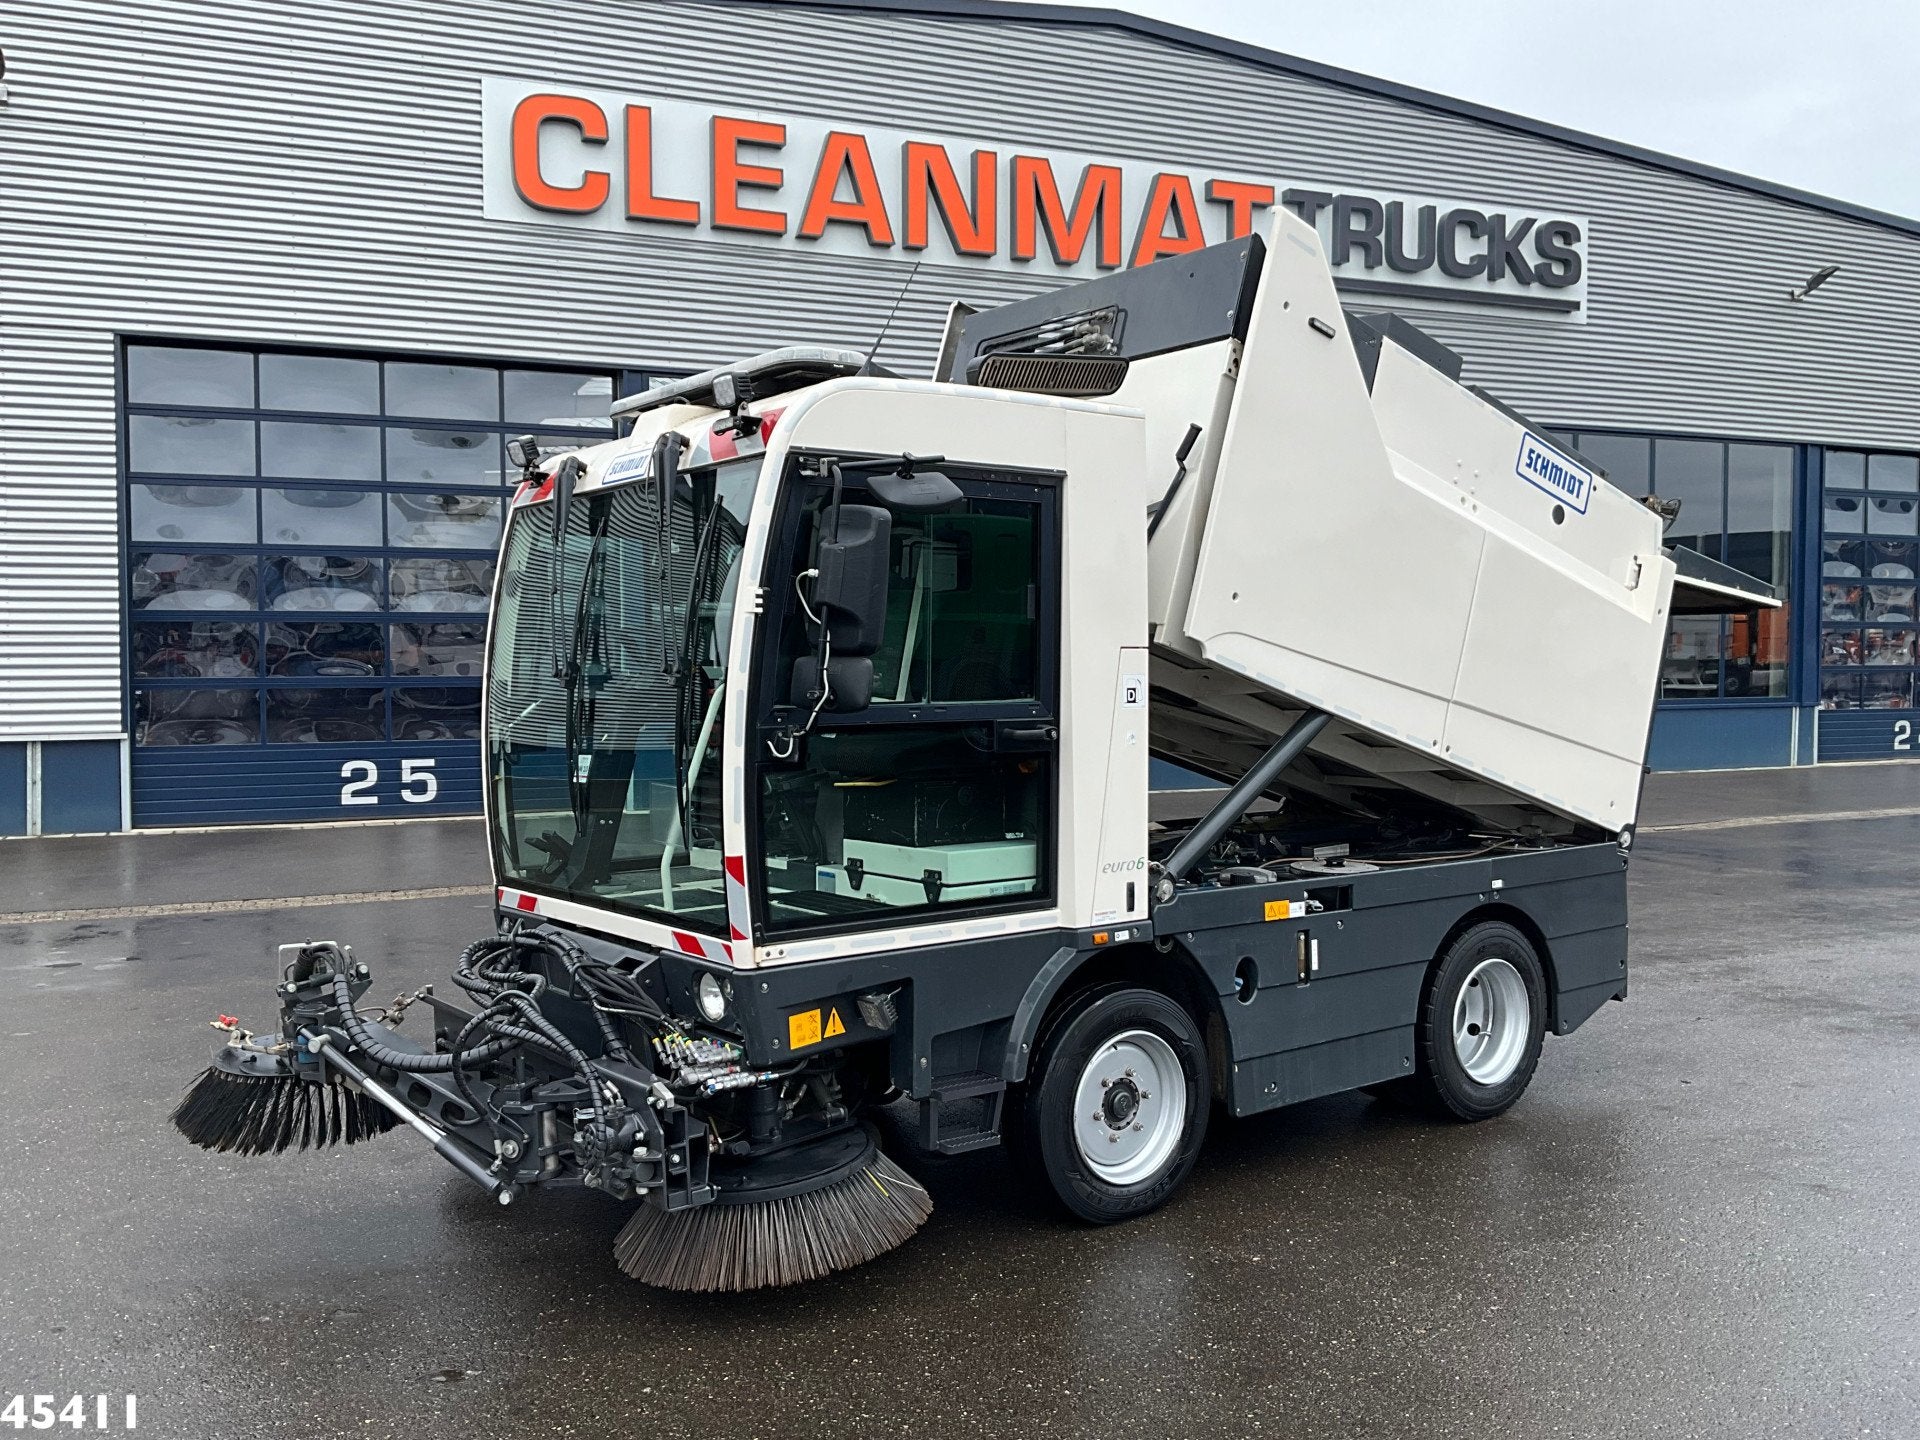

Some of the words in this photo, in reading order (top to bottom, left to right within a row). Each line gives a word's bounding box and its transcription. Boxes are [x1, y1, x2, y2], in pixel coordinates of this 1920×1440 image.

[511, 93, 1275, 270] CLEANMAT
[1282, 188, 1582, 289] TRUCKS
[609, 454, 649, 476] SCHMIDT
[1525, 447, 1584, 499] SCHMIDT
[1894, 719, 1920, 750] 2
[1102, 856, 1145, 874] euro6
